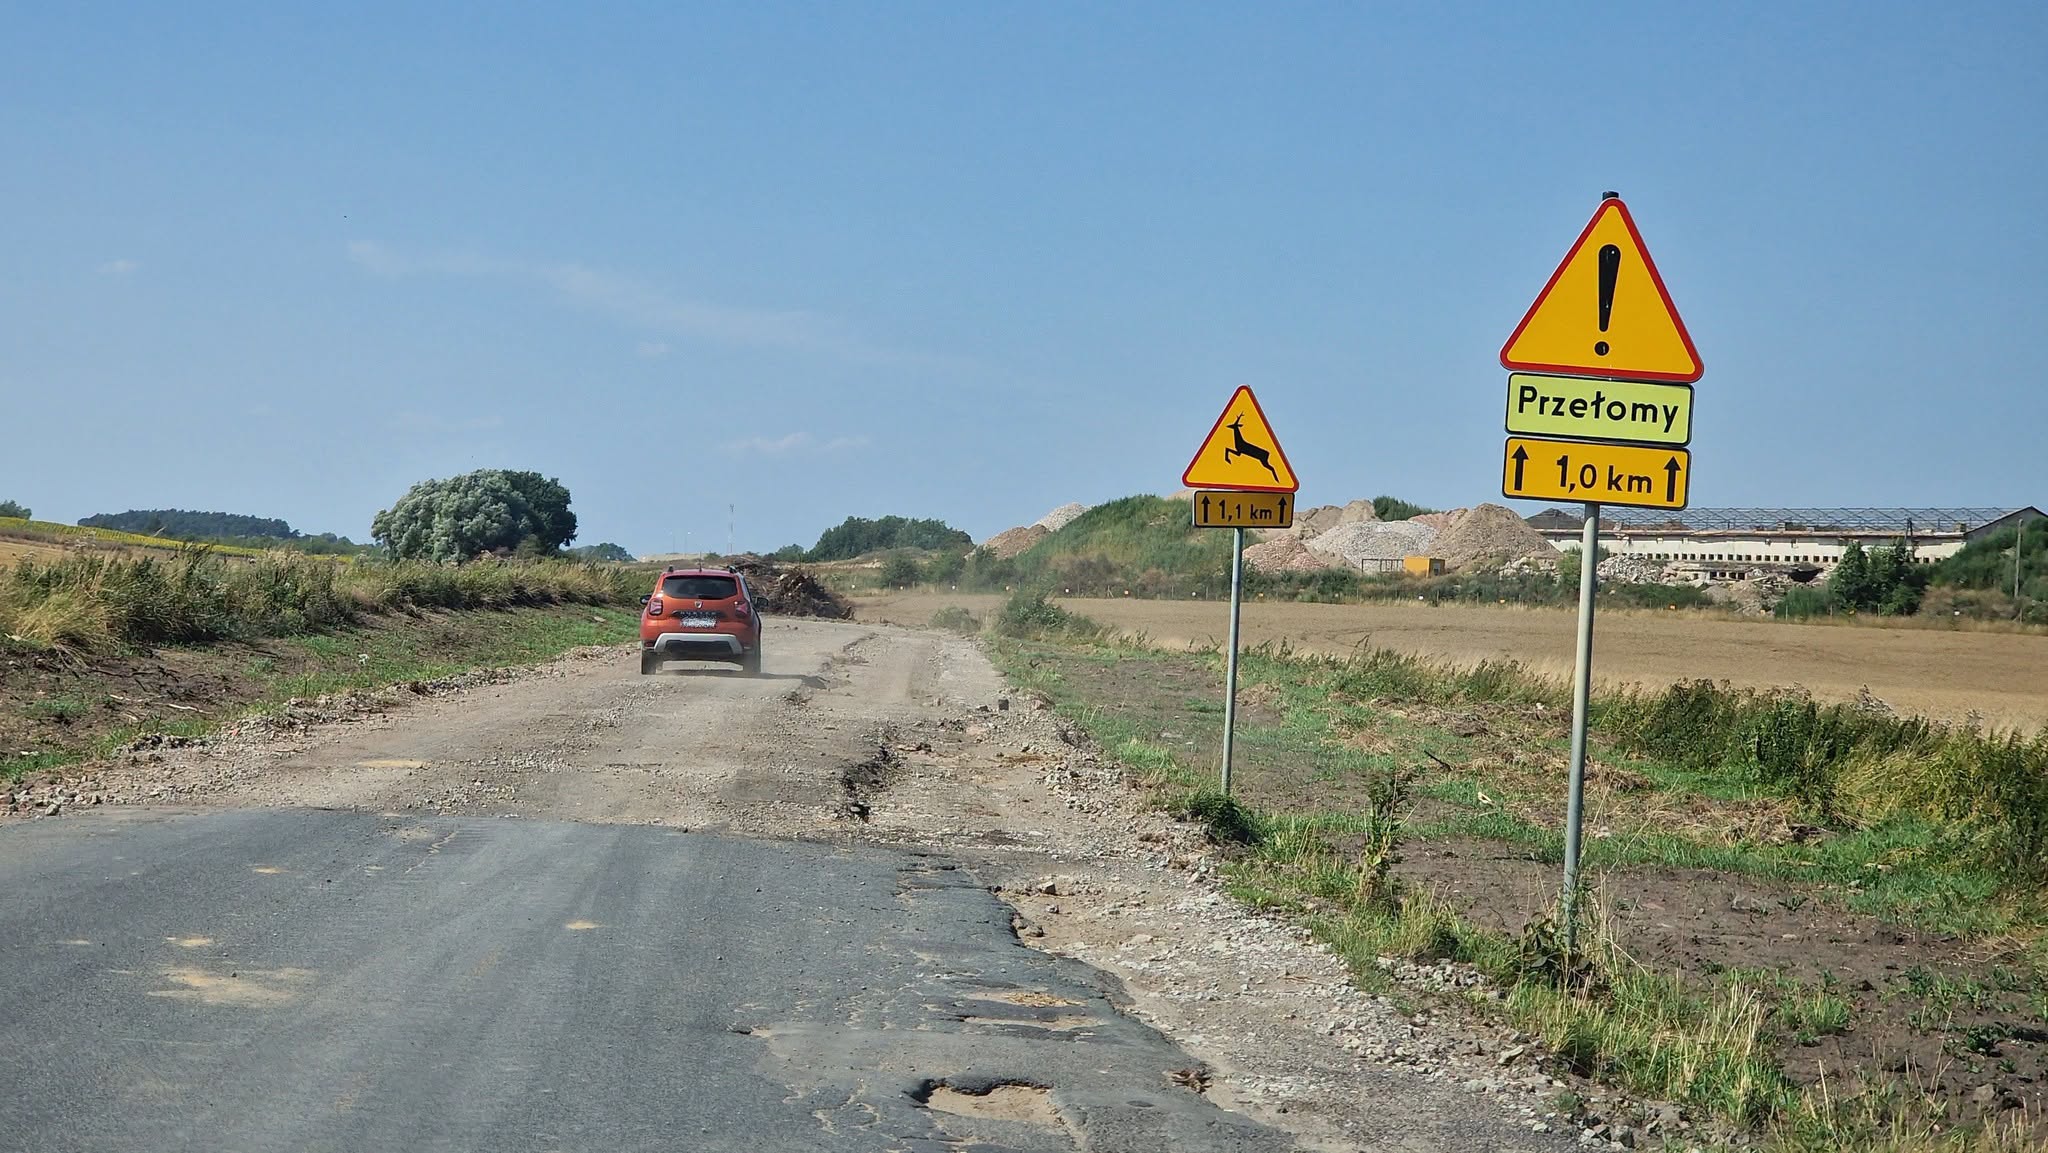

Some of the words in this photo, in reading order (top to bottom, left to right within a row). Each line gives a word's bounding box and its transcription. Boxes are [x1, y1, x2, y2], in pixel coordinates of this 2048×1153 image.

[1518, 385, 1679, 433] Przełomy
[1556, 455, 1597, 494] 1,0
[1607, 465, 1653, 494] km
[1218, 499, 1242, 522] 1,1
[1250, 503, 1272, 520] km
